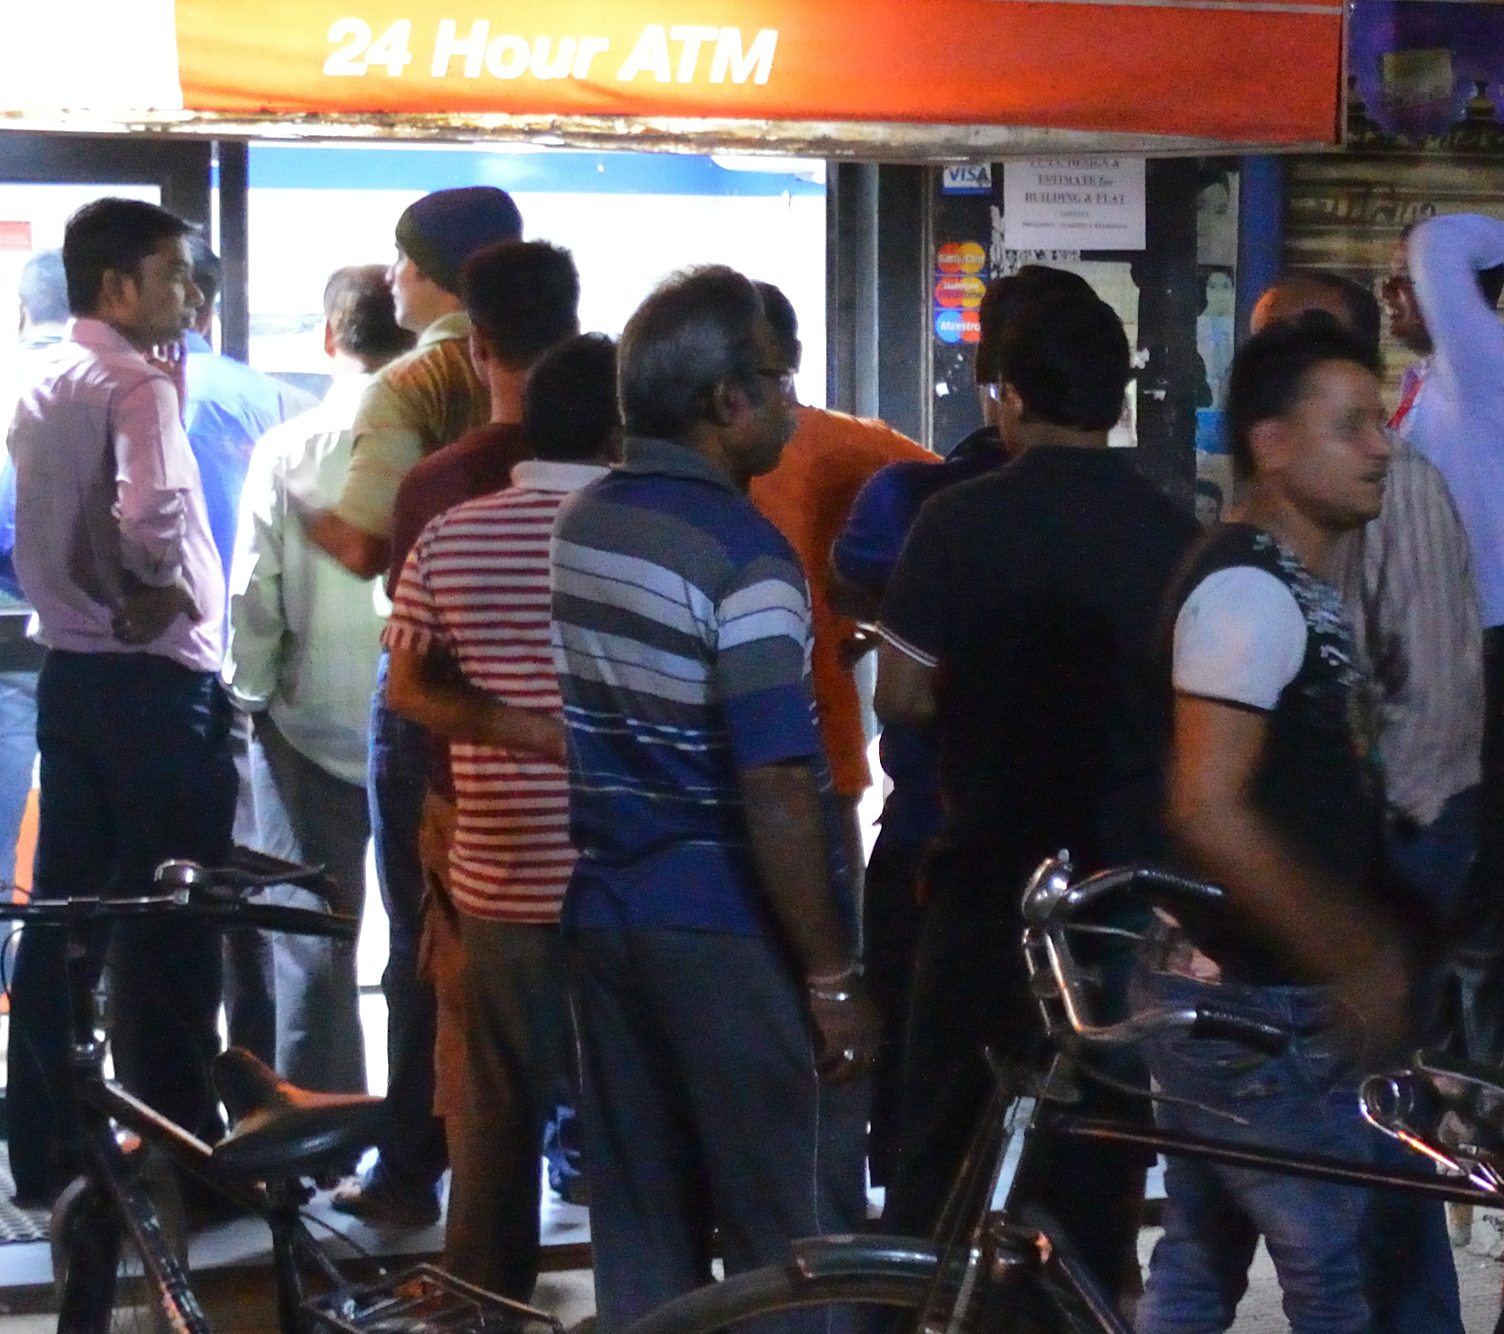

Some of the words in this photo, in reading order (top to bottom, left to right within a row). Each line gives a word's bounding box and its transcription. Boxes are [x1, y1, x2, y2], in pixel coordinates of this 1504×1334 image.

[323, 17, 412, 77] 24
[431, 19, 610, 79] Hour
[617, 24, 779, 85] ATM
[949, 166, 989, 185] VISA
[940, 320, 981, 332] Maestro
